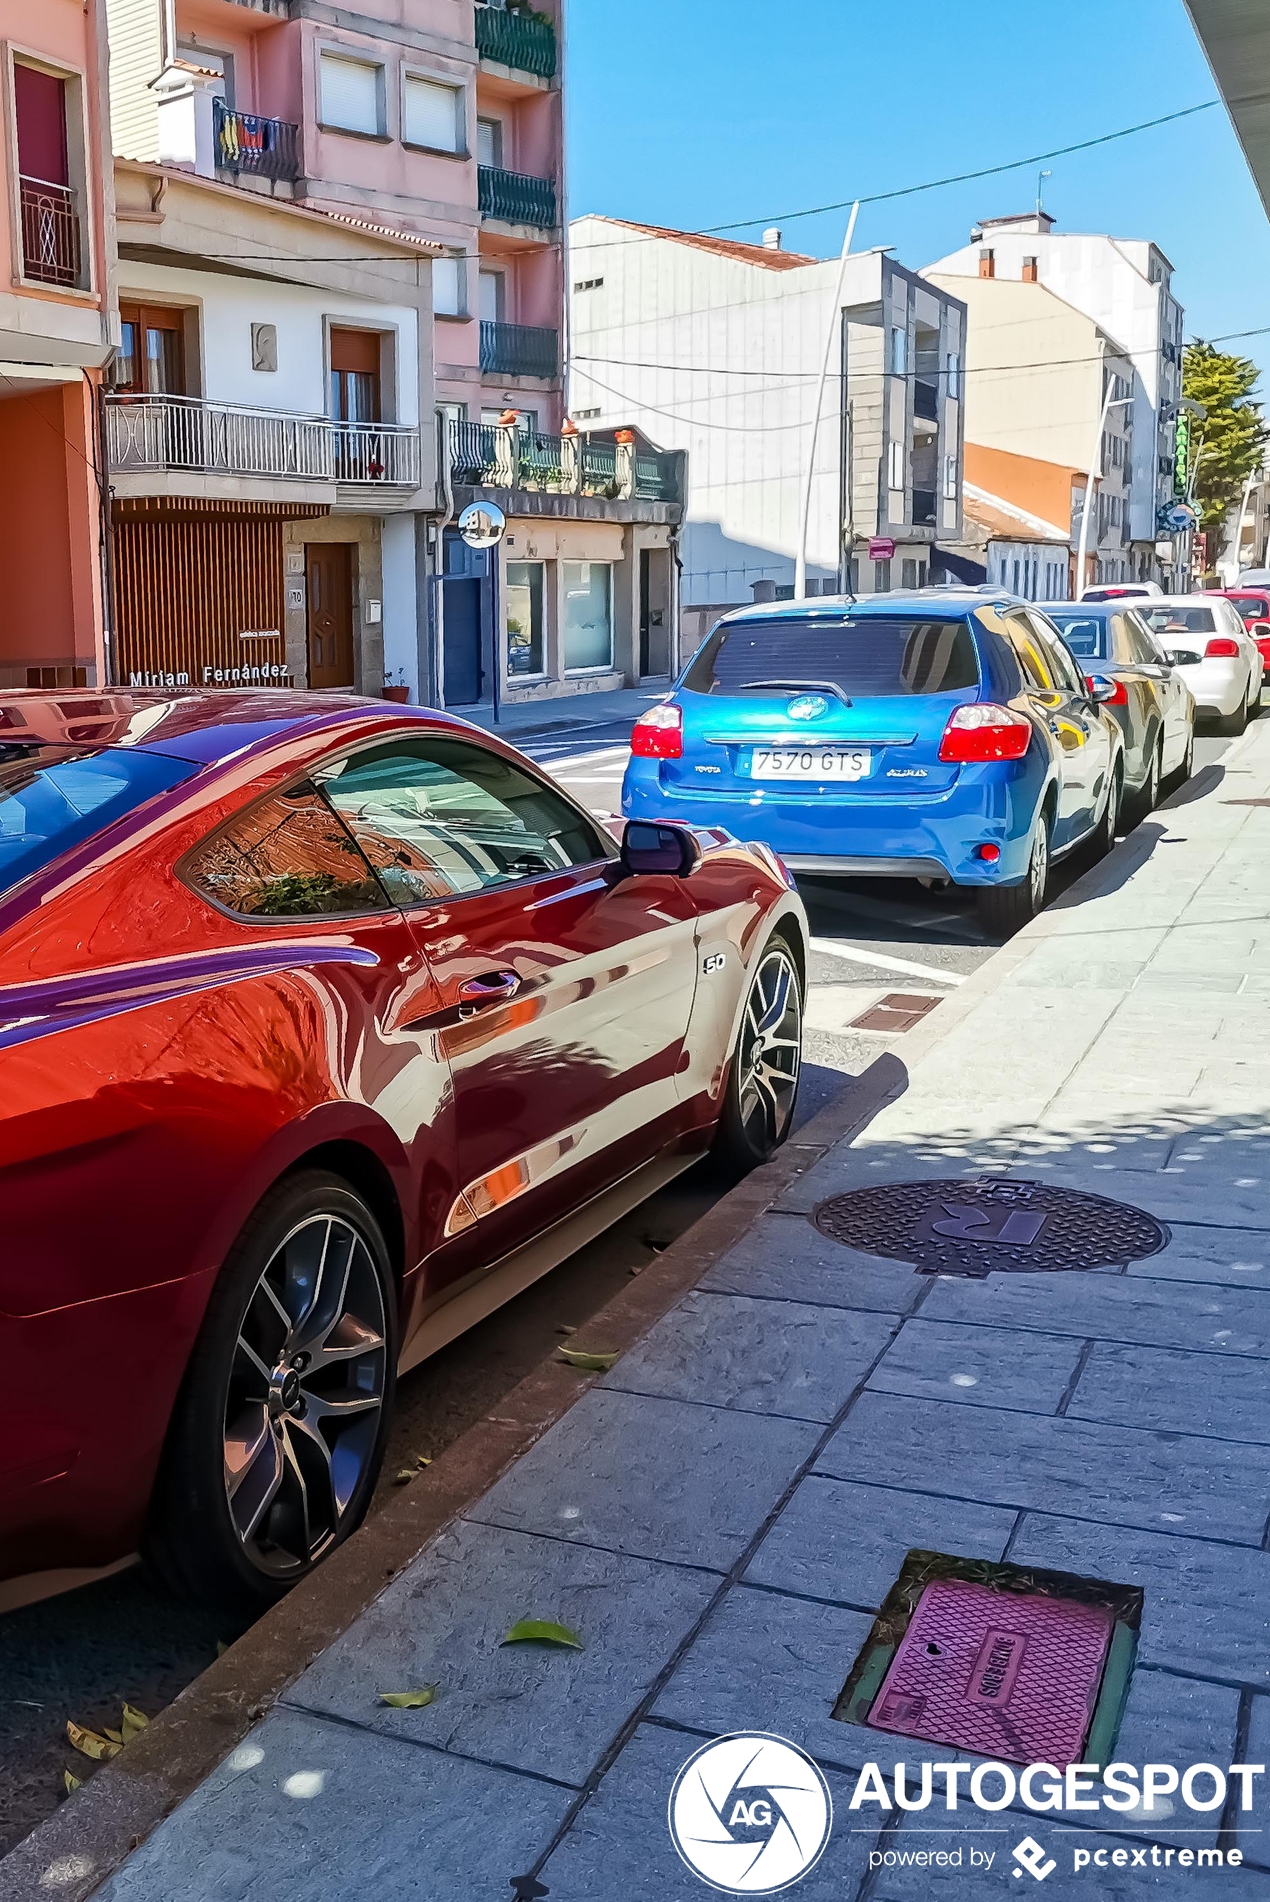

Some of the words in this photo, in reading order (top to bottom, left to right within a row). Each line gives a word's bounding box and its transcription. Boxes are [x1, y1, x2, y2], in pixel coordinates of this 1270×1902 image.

[130, 670, 189, 687] Miriam
[203, 661, 289, 683] Fernández
[758, 752, 812, 771] 7570
[821, 752, 863, 771] GTS
